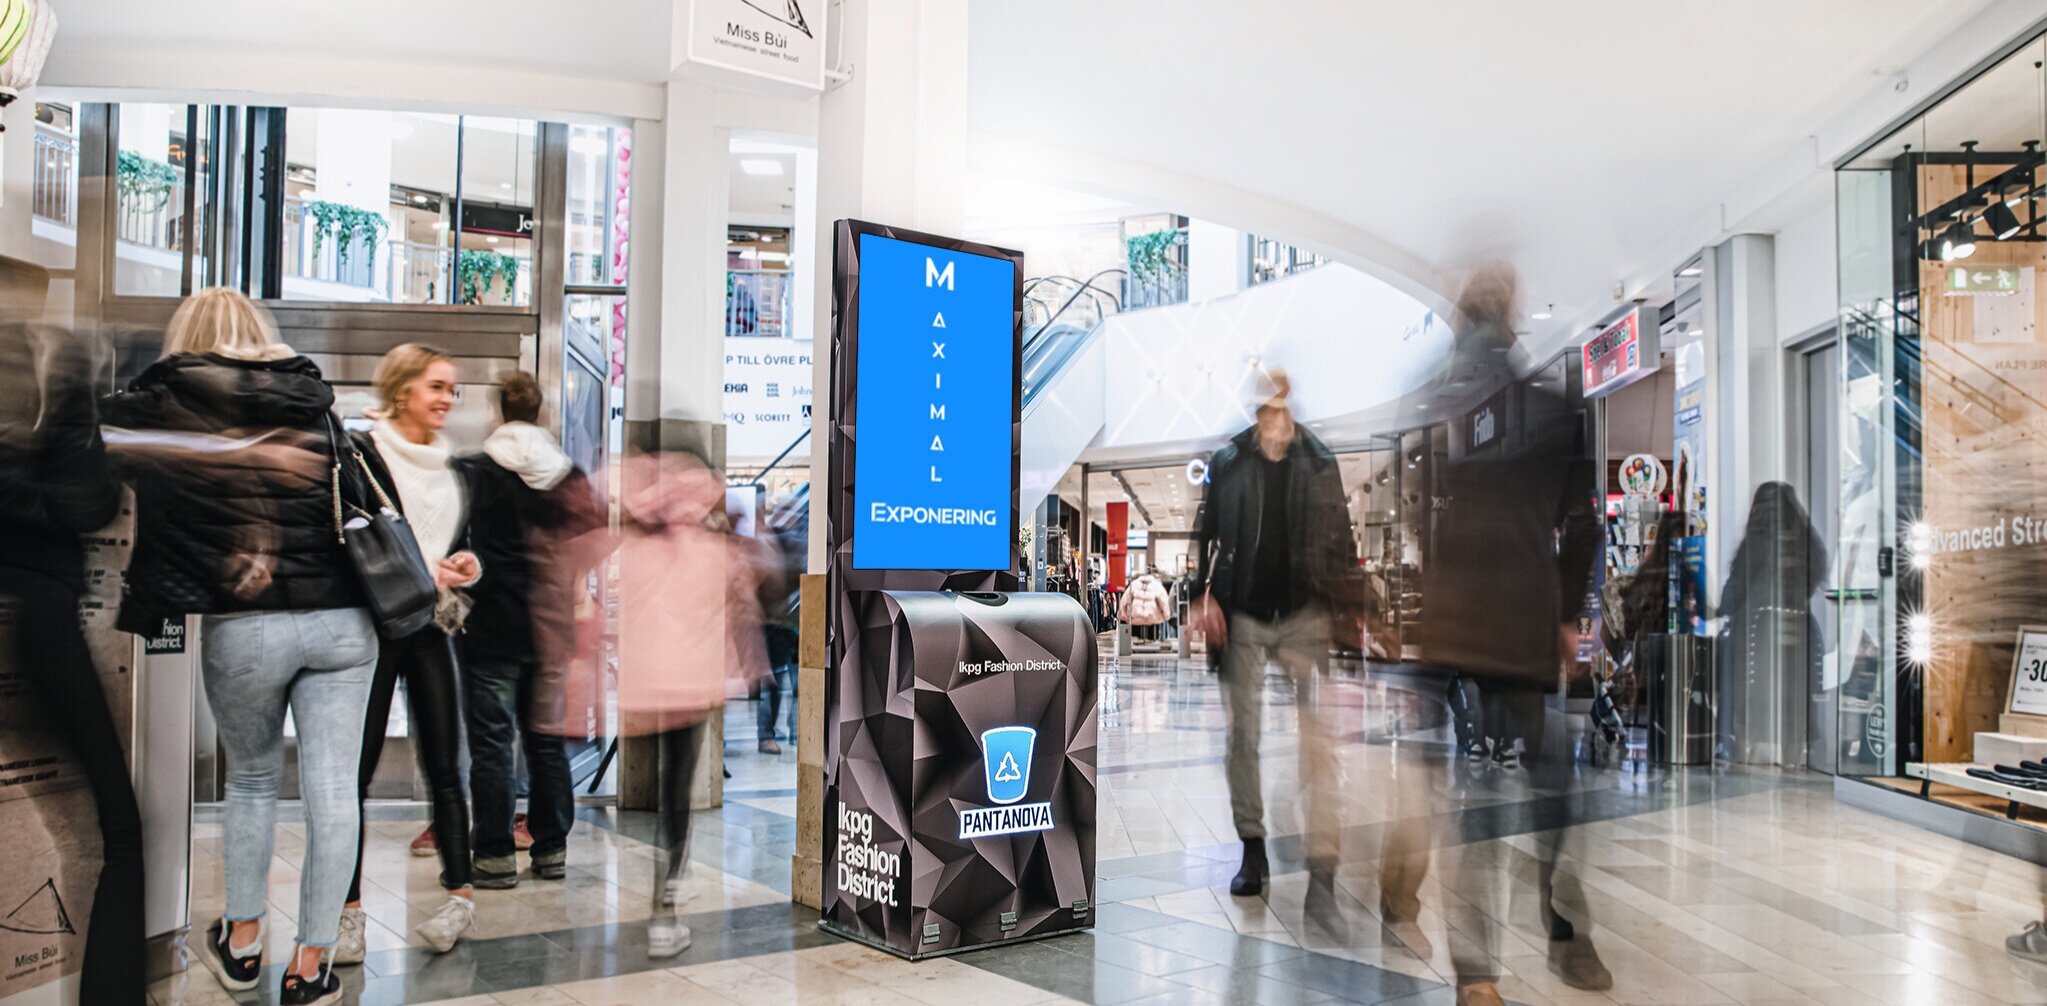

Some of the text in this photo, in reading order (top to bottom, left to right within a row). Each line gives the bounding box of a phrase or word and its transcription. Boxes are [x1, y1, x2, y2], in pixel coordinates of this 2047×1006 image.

[727, 22, 760, 43] Miss
[737, 355, 760, 365] TILL
[764, 353, 795, 366] ÖVRE
[755, 413, 791, 422] SCORETT
[1925, 517, 2005, 554] dvanced
[984, 660, 1023, 673] Fashion
[1026, 659, 1061, 672] District
[963, 805, 1050, 834] PANTANOVA
[838, 833, 900, 878] Fashion
[837, 861, 898, 907] District.
[15, 952, 39, 969] Miss
